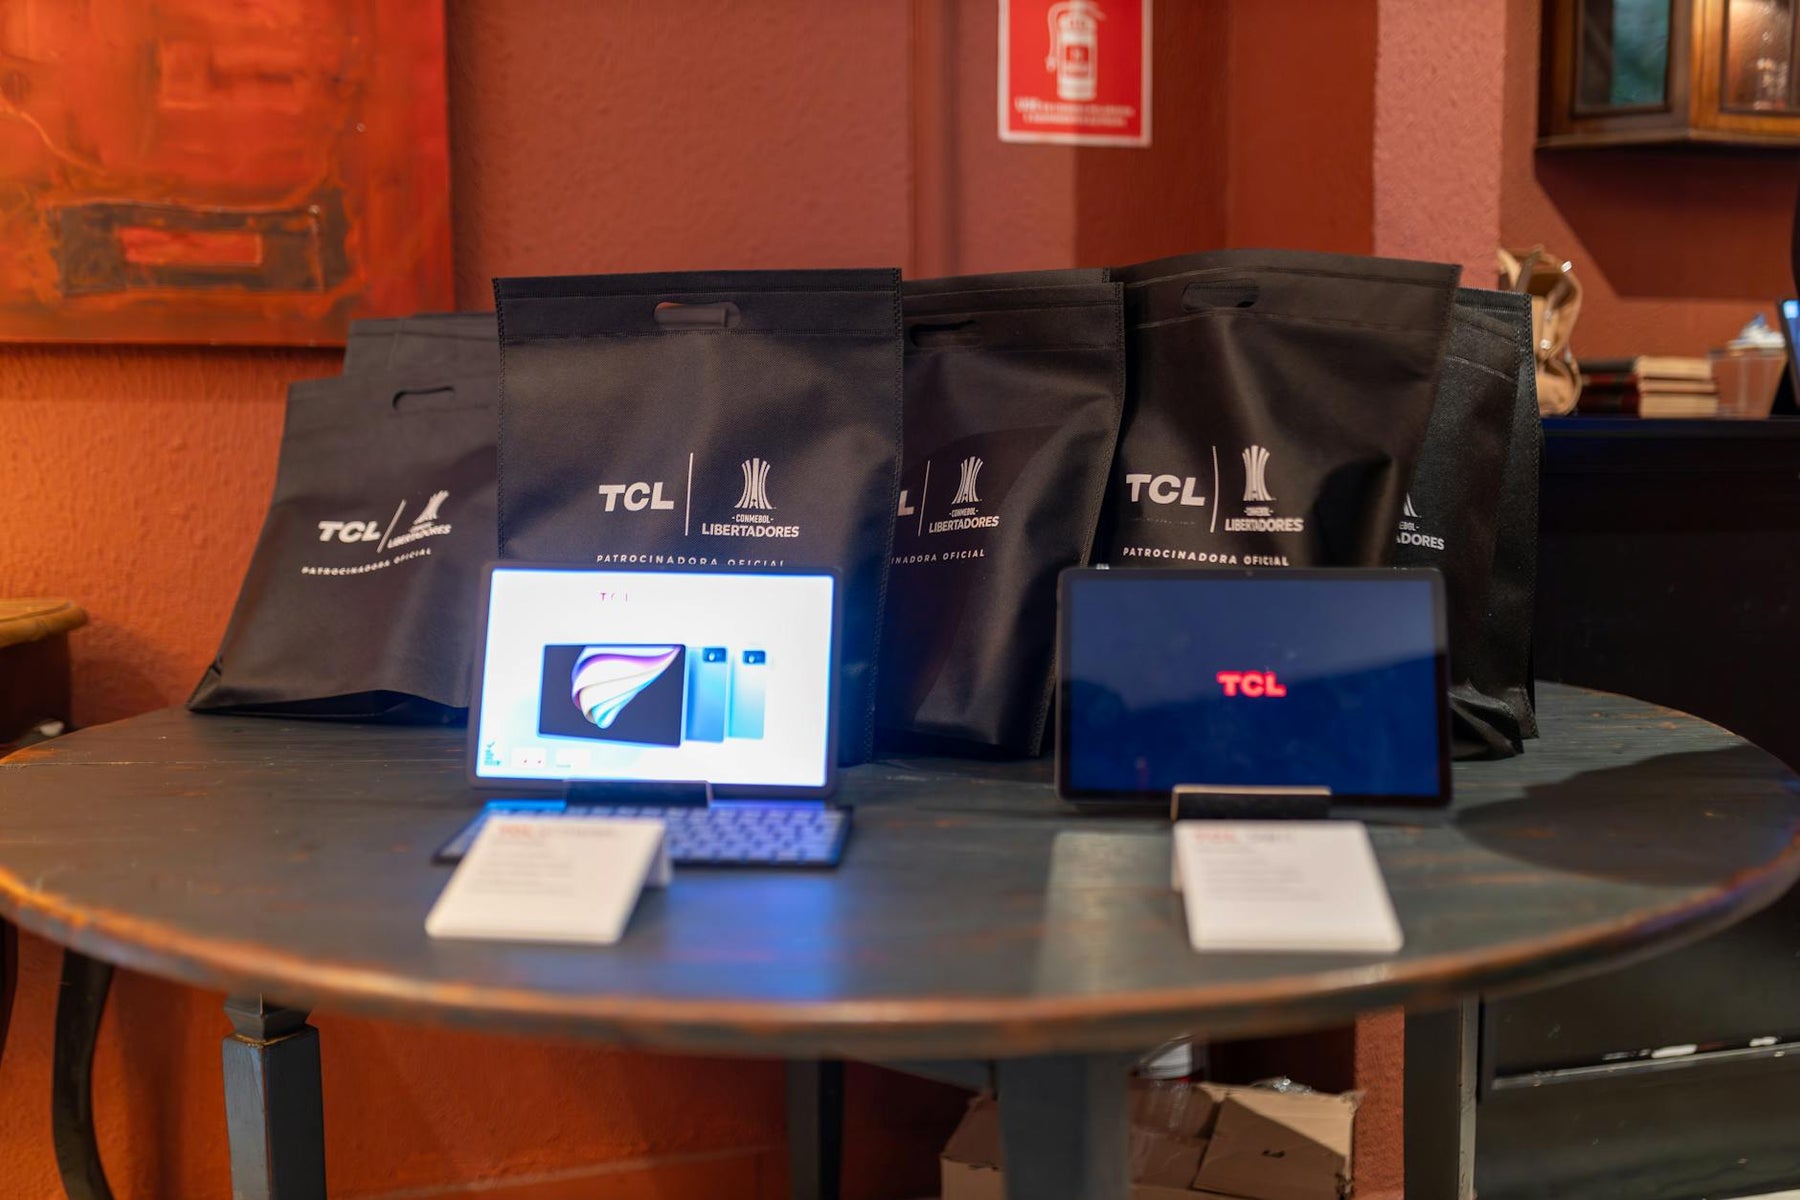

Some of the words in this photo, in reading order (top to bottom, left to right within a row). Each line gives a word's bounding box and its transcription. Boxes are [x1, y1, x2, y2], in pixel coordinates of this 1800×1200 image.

[598, 482, 674, 512] TCL
[1126, 474, 1205, 506] TCL
[318, 520, 381, 543] TCL
[701, 523, 800, 538] LIBERTADORES
[928, 516, 1000, 533] LIBERTADORES
[597, 554, 718, 566] PATROCINADORA
[942, 549, 985, 560] OFICIAL
[1123, 547, 1238, 565] PATROCINADORA
[1243, 555, 1289, 566] OFICIAL
[301, 560, 391, 576] PATROCINADORA
[1216, 670, 1287, 697] TCL
